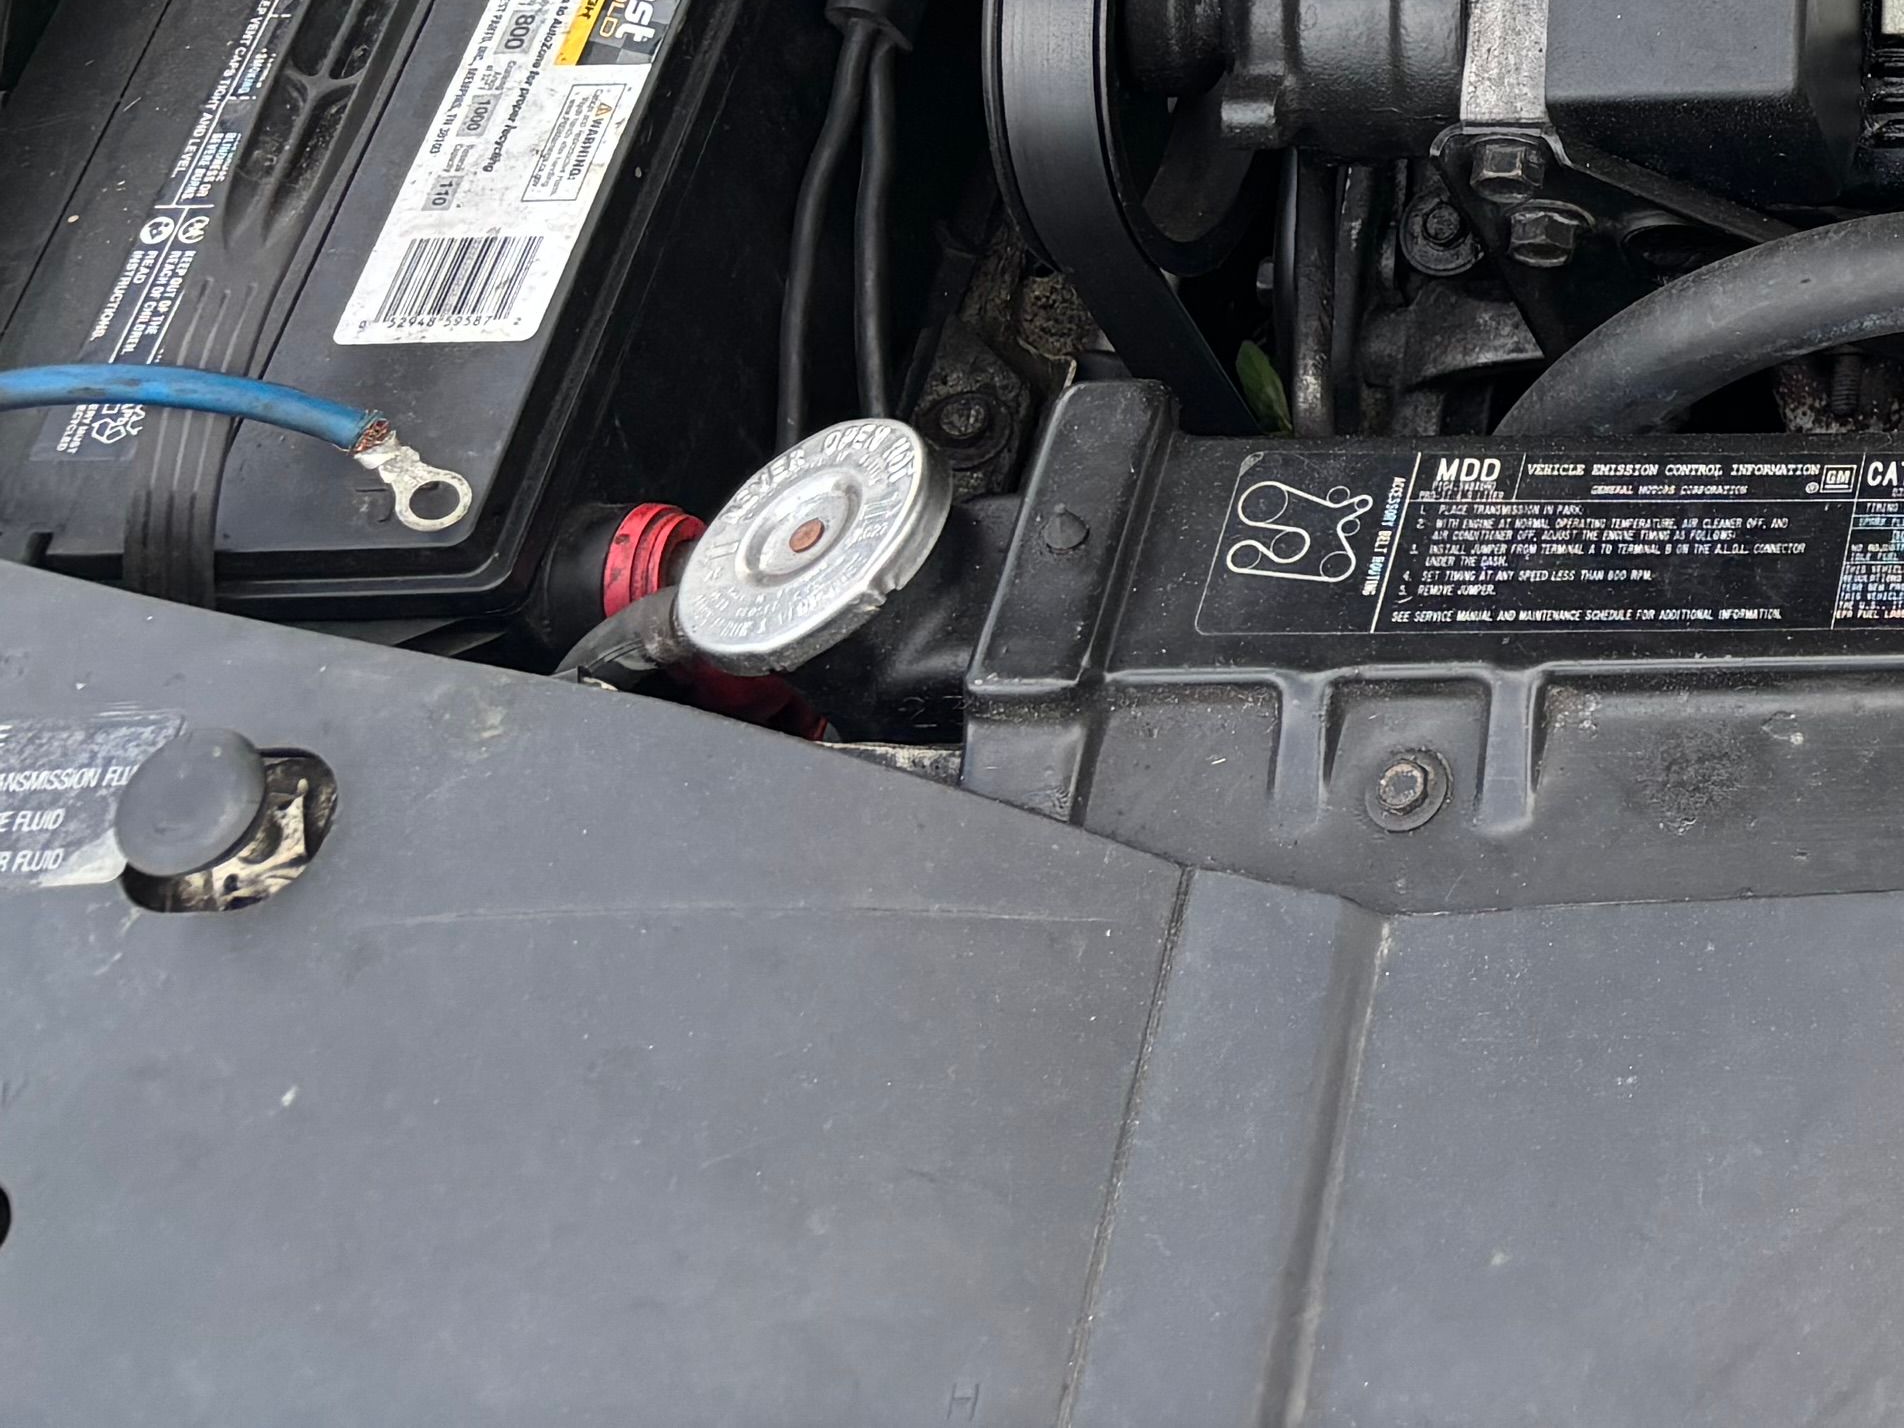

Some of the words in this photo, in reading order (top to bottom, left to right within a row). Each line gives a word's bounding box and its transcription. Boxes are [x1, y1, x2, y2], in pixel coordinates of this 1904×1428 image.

[239, 17, 262, 45] VENT
[501, 14, 536, 49] 800
[530, 18, 563, 67] AutoZone
[222, 46, 247, 76] CAPS
[465, 100, 492, 131] 1000
[566, 117, 604, 180] WARNING:
[430, 180, 455, 205] 110
[387, 316, 434, 327] 52948
[444, 315, 493, 327] 59587
[823, 423, 891, 456] OPEN
[1437, 457, 1501, 481] MDD
[1527, 464, 1586, 476] VEHICLE
[1591, 464, 1659, 476] EMISSION
[1664, 464, 1723, 476] CONTROL
[1730, 464, 1821, 476] INFORMATION
[1825, 470, 1851, 484] GM
[1590, 485, 1634, 495] GENERAL
[1638, 485, 1675, 495] MOTORS
[1438, 504, 1468, 516] PLACE
[1472, 504, 1540, 516] TRANSMISSION
[1421, 570, 1441, 582] SET
[1444, 570, 1476, 582] TIMING
[1497, 570, 1514, 582] ANY
[1518, 570, 1548, 582] SPEED
[1550, 570, 1576, 582] LESS
[1580, 570, 1605, 582] THAN
[1417, 584, 1454, 596] REMOVE
[1391, 610, 1412, 623] SEE
[1413, 610, 1453, 622] SERVICE
[1456, 610, 1492, 622] MANUAL
[1496, 610, 1517, 622] AND
[1519, 610, 1582, 622] MAINTENANCE
[1584, 610, 1633, 622] SCHEDULE
[1635, 609, 1656, 620] FOR
[1658, 609, 1714, 620] ADDITIONAL
[13, 808, 66, 832] FLUID
[12, 848, 64, 873] FLUID
